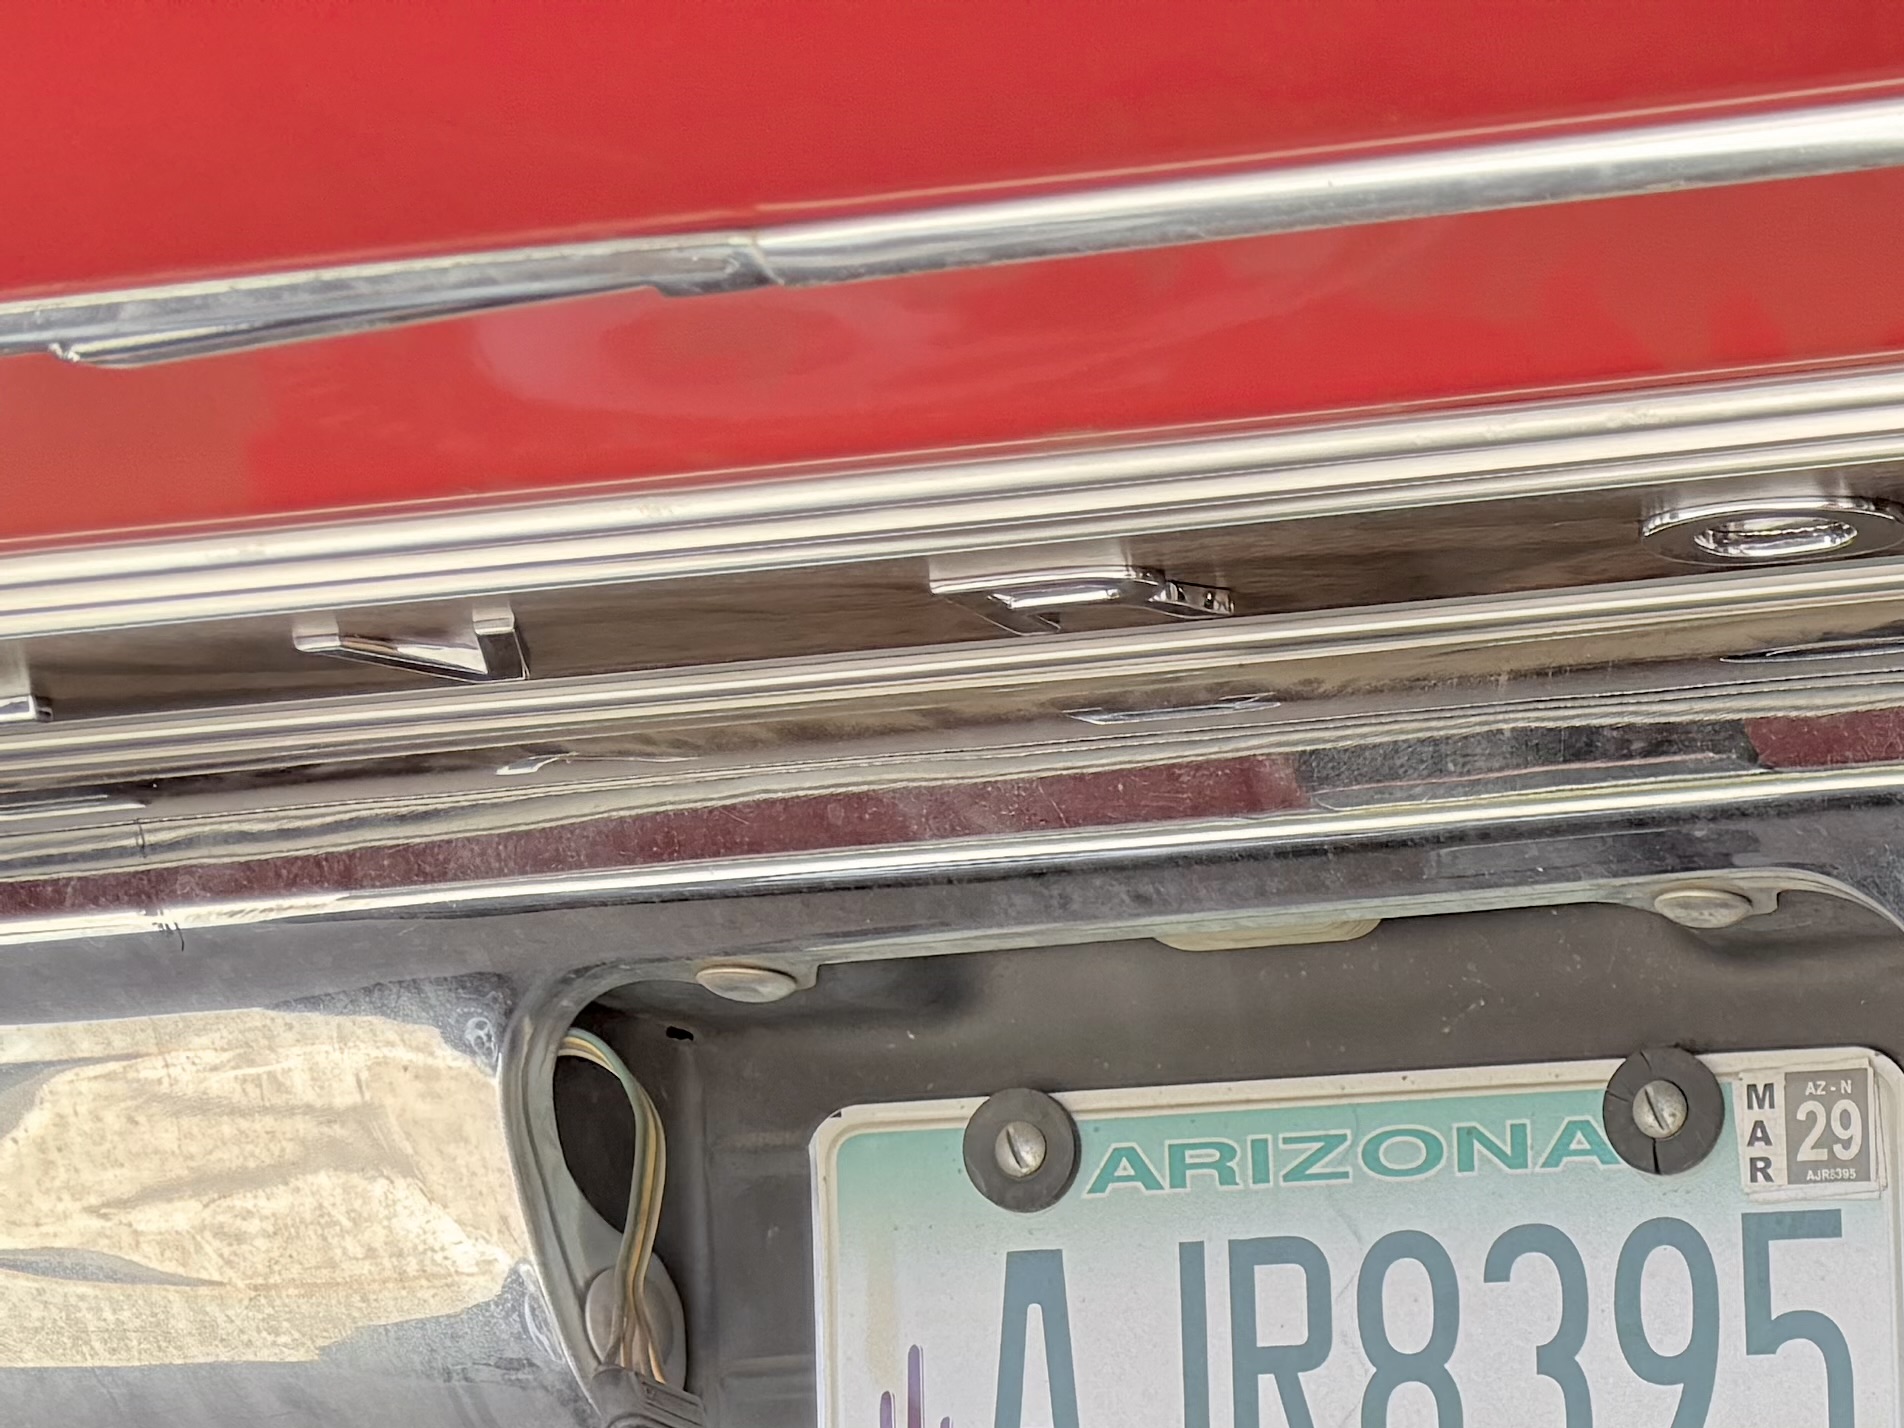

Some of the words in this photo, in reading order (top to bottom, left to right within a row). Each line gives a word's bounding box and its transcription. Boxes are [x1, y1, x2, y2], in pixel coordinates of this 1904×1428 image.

[1084, 1116, 1624, 1197] ARIZONA
[1746, 1082, 1775, 1184] MAR
[1796, 1098, 1863, 1162] 29
[1806, 1167, 1857, 1181] AJR8395
